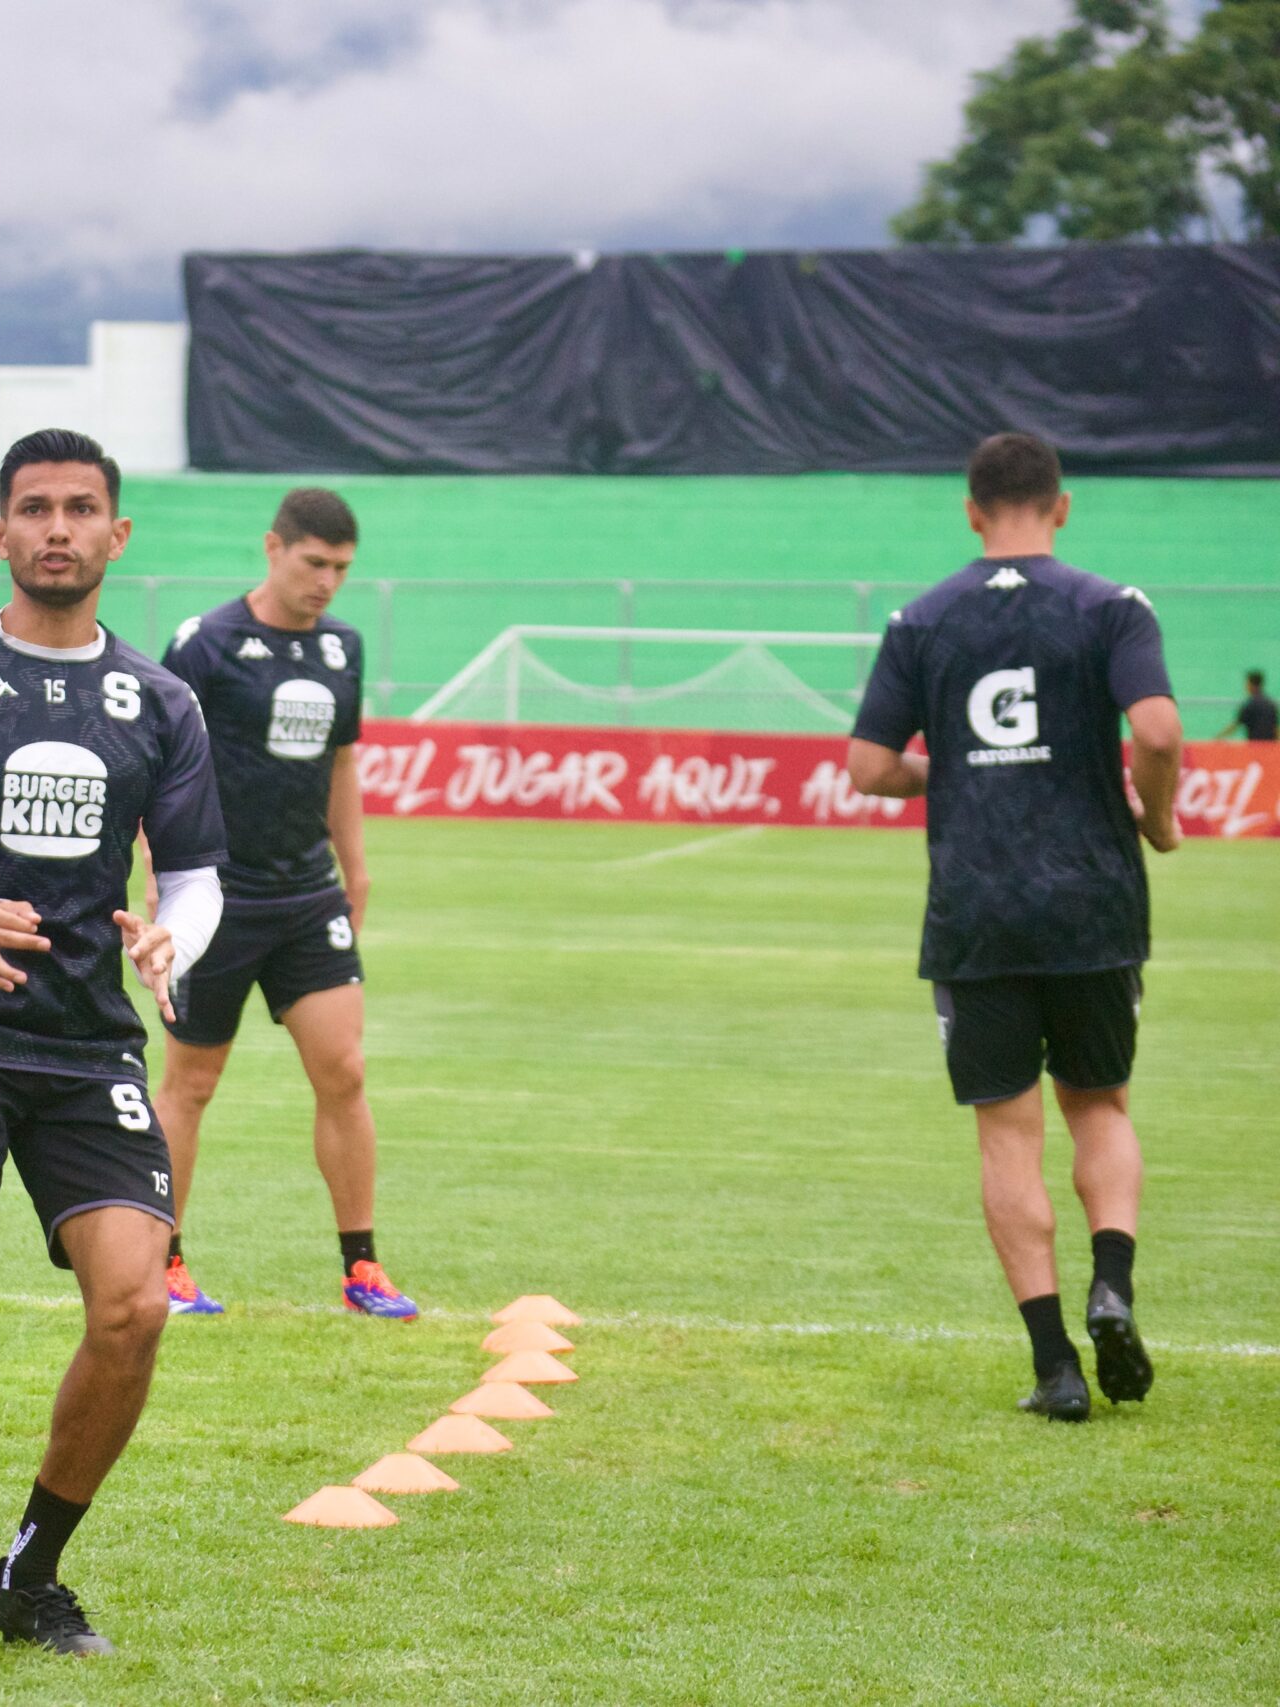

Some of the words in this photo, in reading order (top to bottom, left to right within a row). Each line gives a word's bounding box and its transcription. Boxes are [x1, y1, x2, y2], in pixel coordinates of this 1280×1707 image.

[319, 633, 347, 671] S
[43, 678, 66, 703] 15
[103, 671, 141, 721] S
[967, 666, 1039, 748] G
[272, 701, 336, 720] BURGER
[269, 718, 332, 741] KING
[966, 746, 1052, 767] GATORADE
[3, 773, 107, 804] BURGER
[445, 744, 628, 816] JUGAR
[0, 798, 104, 837] KING
[326, 915, 353, 950] S
[110, 1083, 151, 1131] S
[151, 1170, 169, 1197] 15
